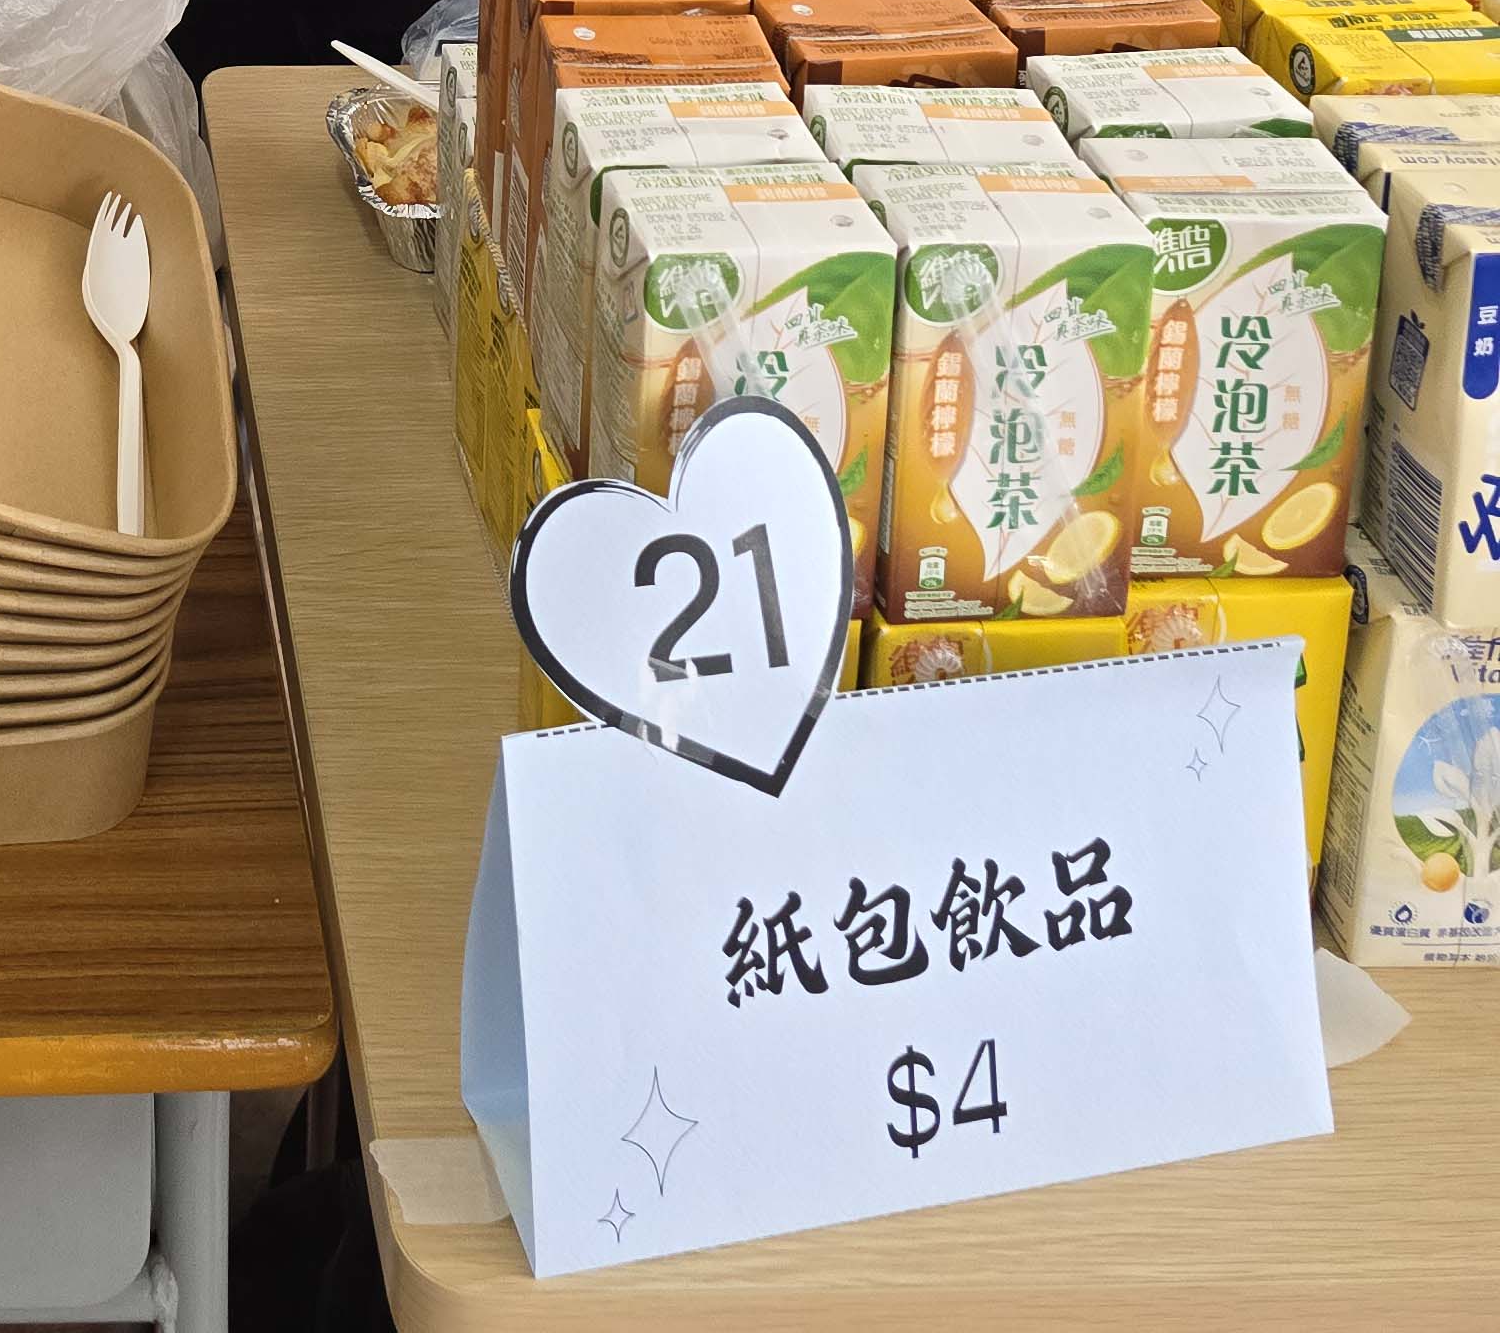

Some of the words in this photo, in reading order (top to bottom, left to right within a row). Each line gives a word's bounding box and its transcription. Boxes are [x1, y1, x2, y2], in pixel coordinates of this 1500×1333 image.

[1398, 155, 1500, 167] tasoy.com
[1152, 320, 1188, 422] 錫蘭檸檬
[1473, 305, 1499, 358] 豆奶
[931, 351, 964, 458] 錫蘭檸檬
[987, 344, 1048, 529] 冷泡茶
[1206, 316, 1273, 496] 冷泡茶
[633, 522, 790, 683] 21
[721, 837, 1133, 1008] 紙包飲品
[886, 1038, 1008, 1159] $4
